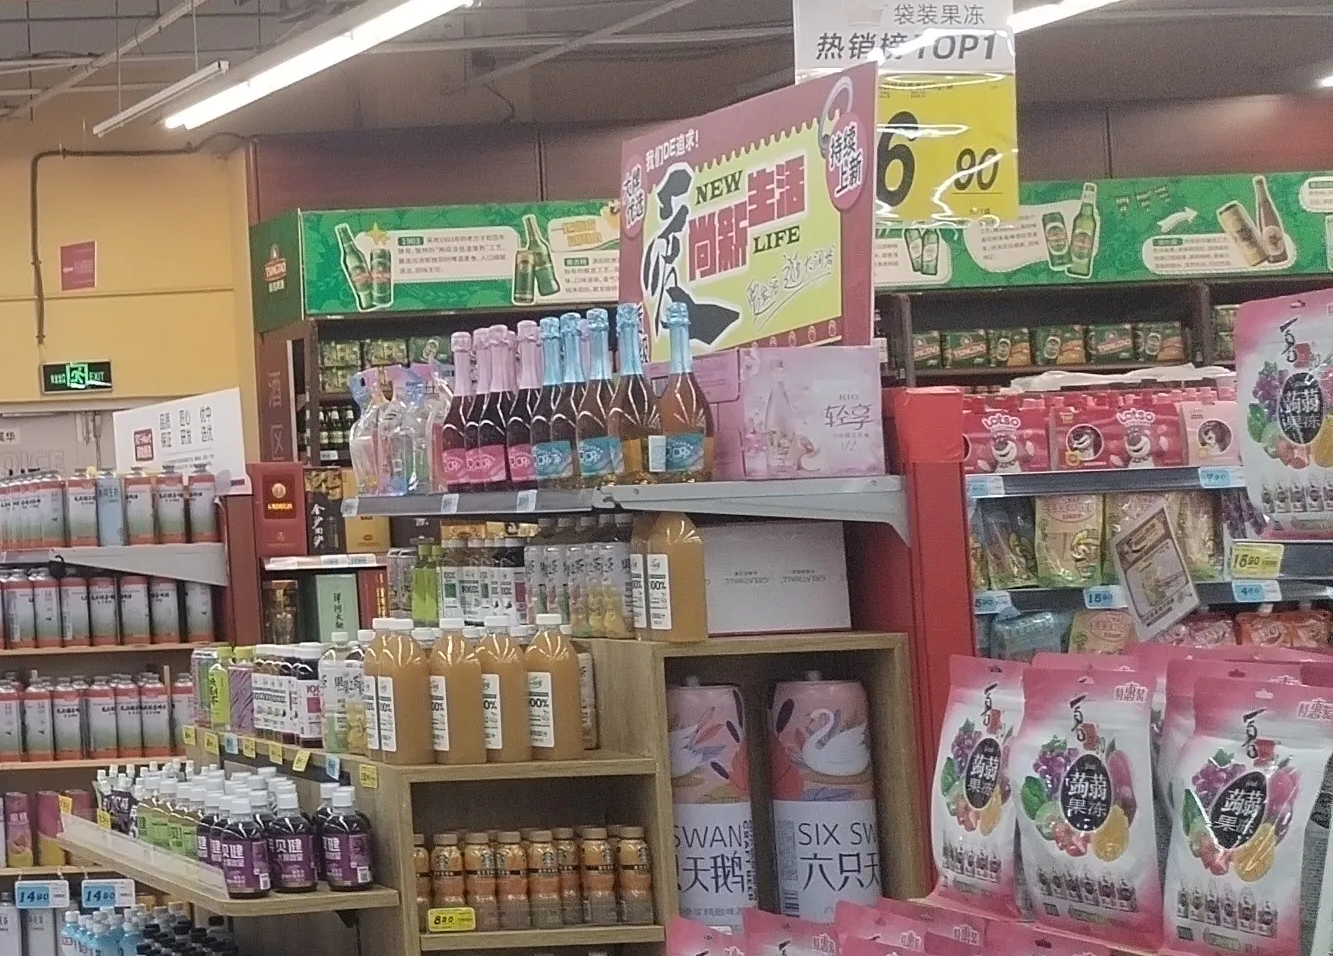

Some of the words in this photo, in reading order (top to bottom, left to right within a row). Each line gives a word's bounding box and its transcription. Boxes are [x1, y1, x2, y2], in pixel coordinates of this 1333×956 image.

[894, 4, 985, 25] 袋装果冻
[877, 111, 919, 207] 6
[695, 170, 744, 206] NEW
[753, 226, 801, 254] LIFE
[1067, 772, 1108, 800] 蒟蒻
[798, 822, 841, 845] SIX
[675, 852, 745, 894] 天鹅
